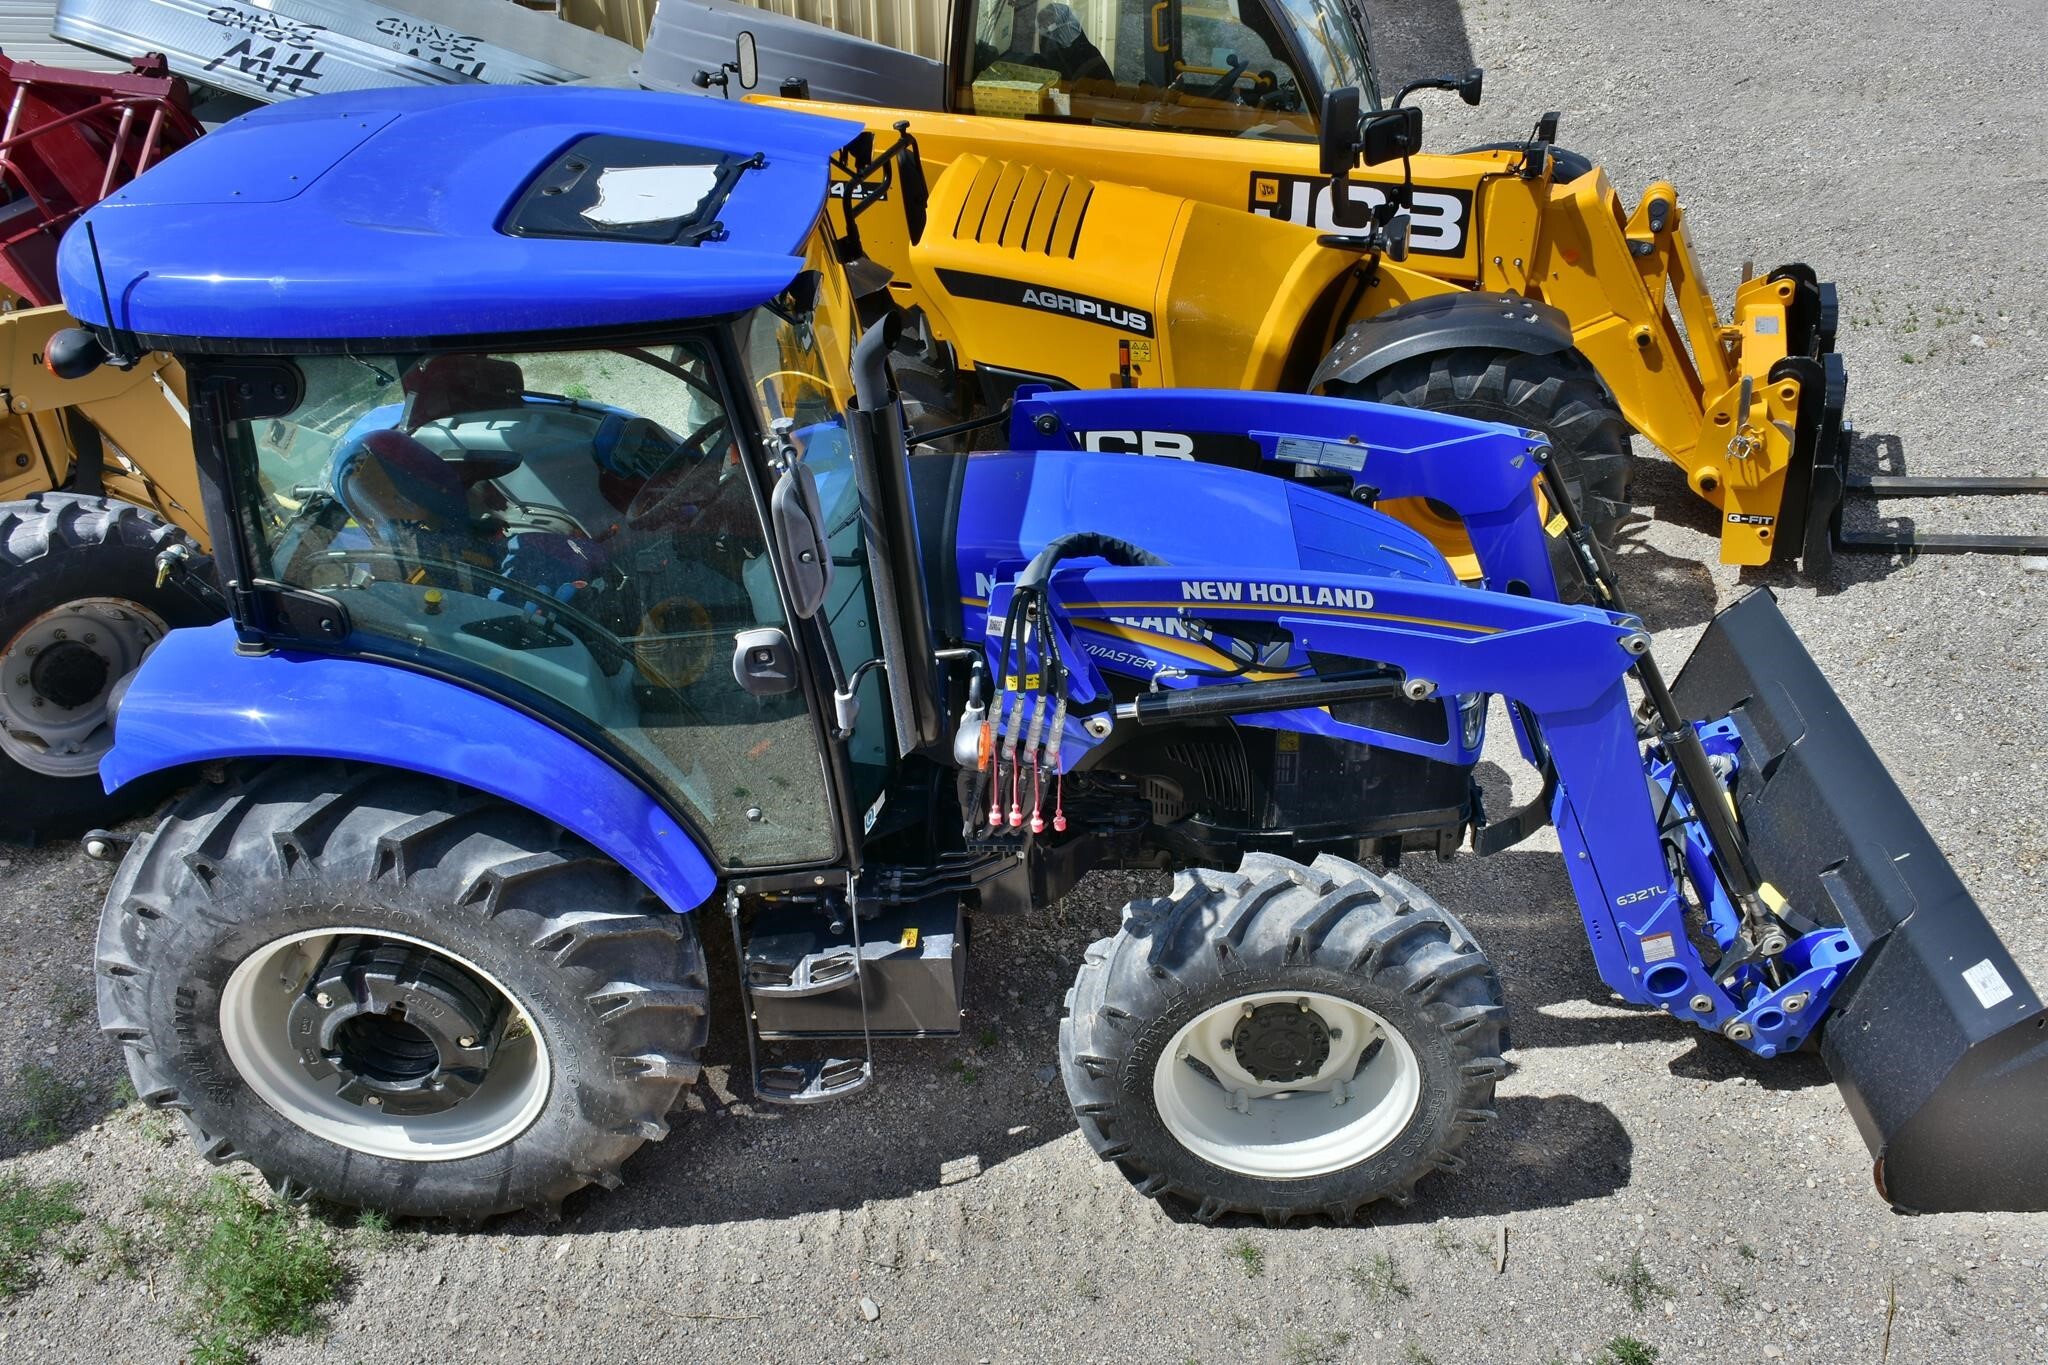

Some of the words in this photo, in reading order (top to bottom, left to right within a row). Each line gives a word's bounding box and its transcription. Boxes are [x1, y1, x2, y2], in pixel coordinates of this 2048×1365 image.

[1022, 288, 1147, 331] AGRIPLUS
[1181, 581, 1242, 601] NEW
[1250, 583, 1374, 610] HOLLAND
[1082, 643, 1158, 671] MASTER
[1616, 885, 1668, 906] 632TL
